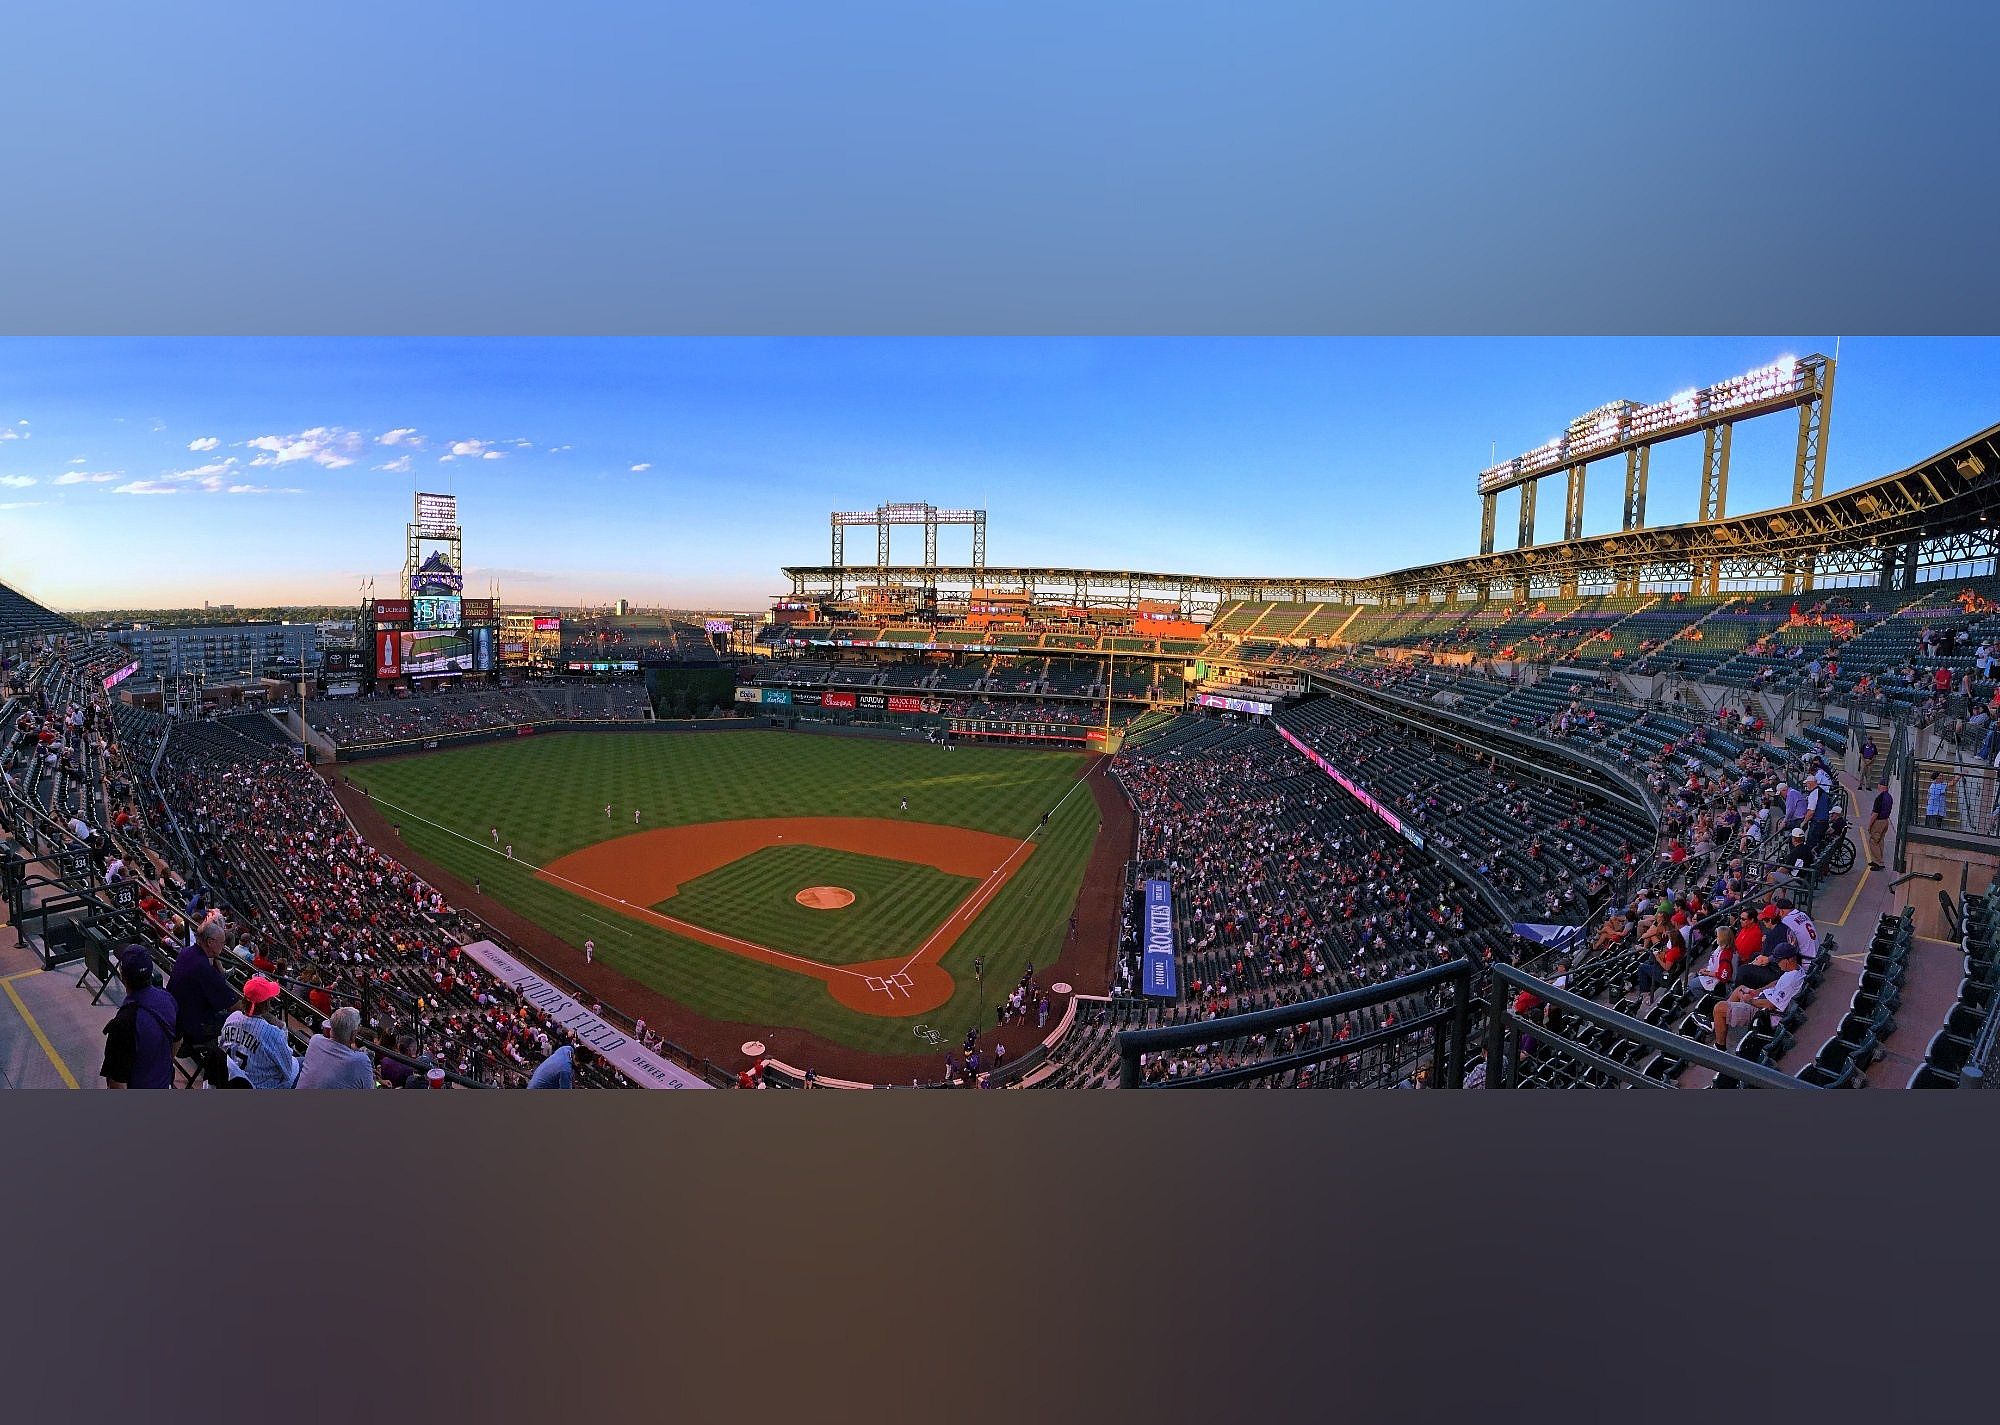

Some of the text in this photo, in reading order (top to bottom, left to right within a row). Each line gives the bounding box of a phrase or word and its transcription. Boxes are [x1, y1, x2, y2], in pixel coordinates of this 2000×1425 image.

[504, 643, 524, 652] KING
[118, 892, 132, 903] 333
[1148, 904, 1173, 954] ROCKIES
[1805, 922, 1817, 941] 6
[512, 975, 627, 1052] COORS FIELD
[224, 1026, 261, 1054] HELTON
